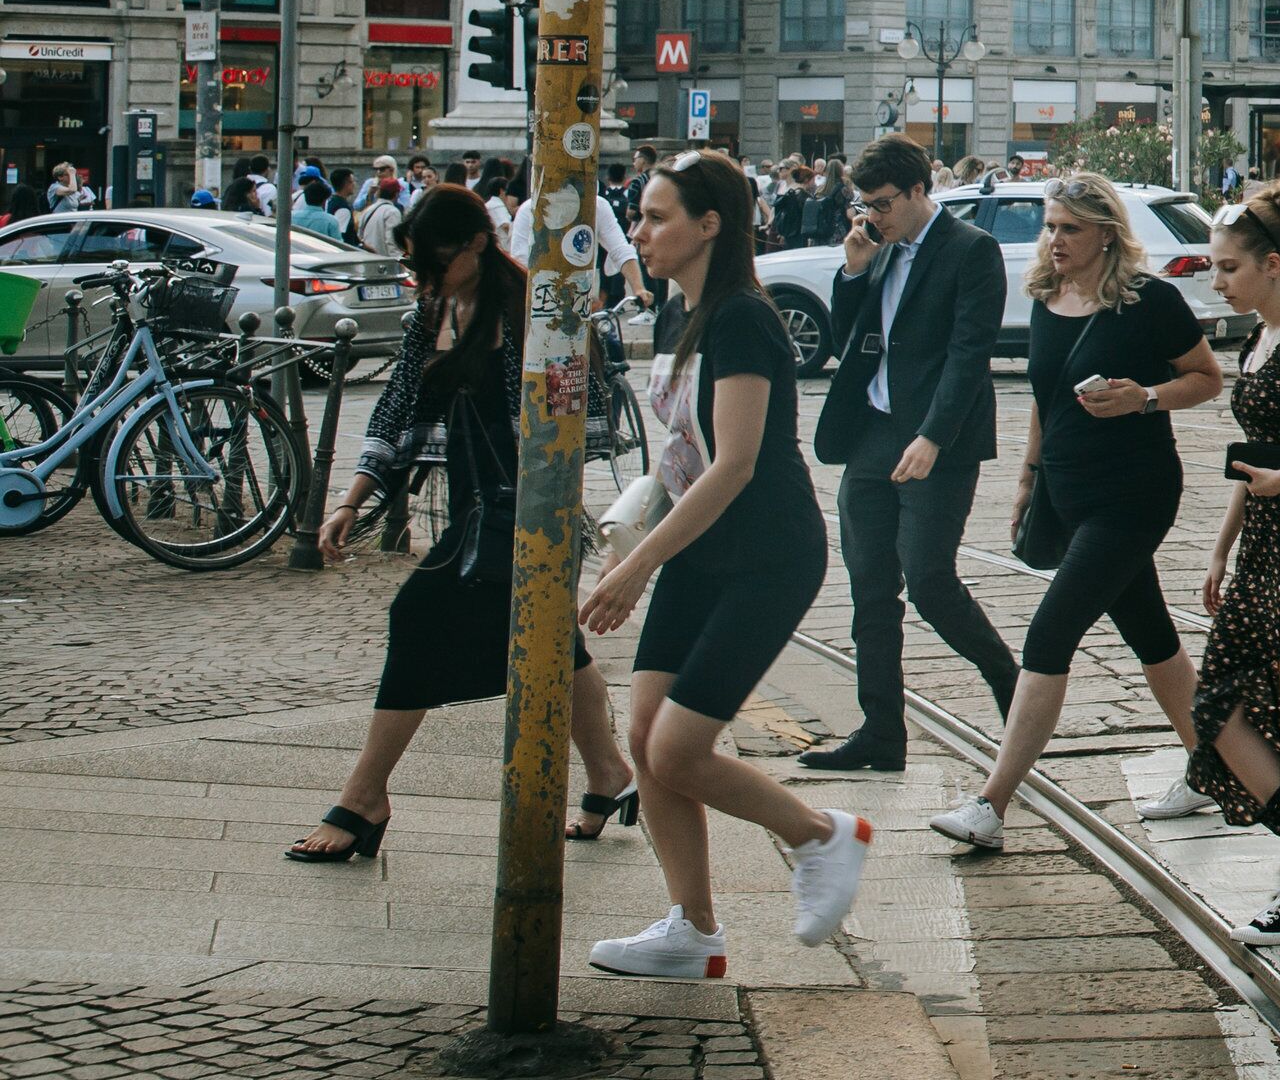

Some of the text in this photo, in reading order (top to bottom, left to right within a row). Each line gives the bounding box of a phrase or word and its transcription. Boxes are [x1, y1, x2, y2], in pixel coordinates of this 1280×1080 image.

[41, 46, 84, 58] UniCredit
[659, 40, 688, 65] M
[185, 63, 270, 86] yamay
[364, 68, 440, 88] yamamay
[694, 95, 706, 115] P
[559, 377, 587, 386] SECRET
